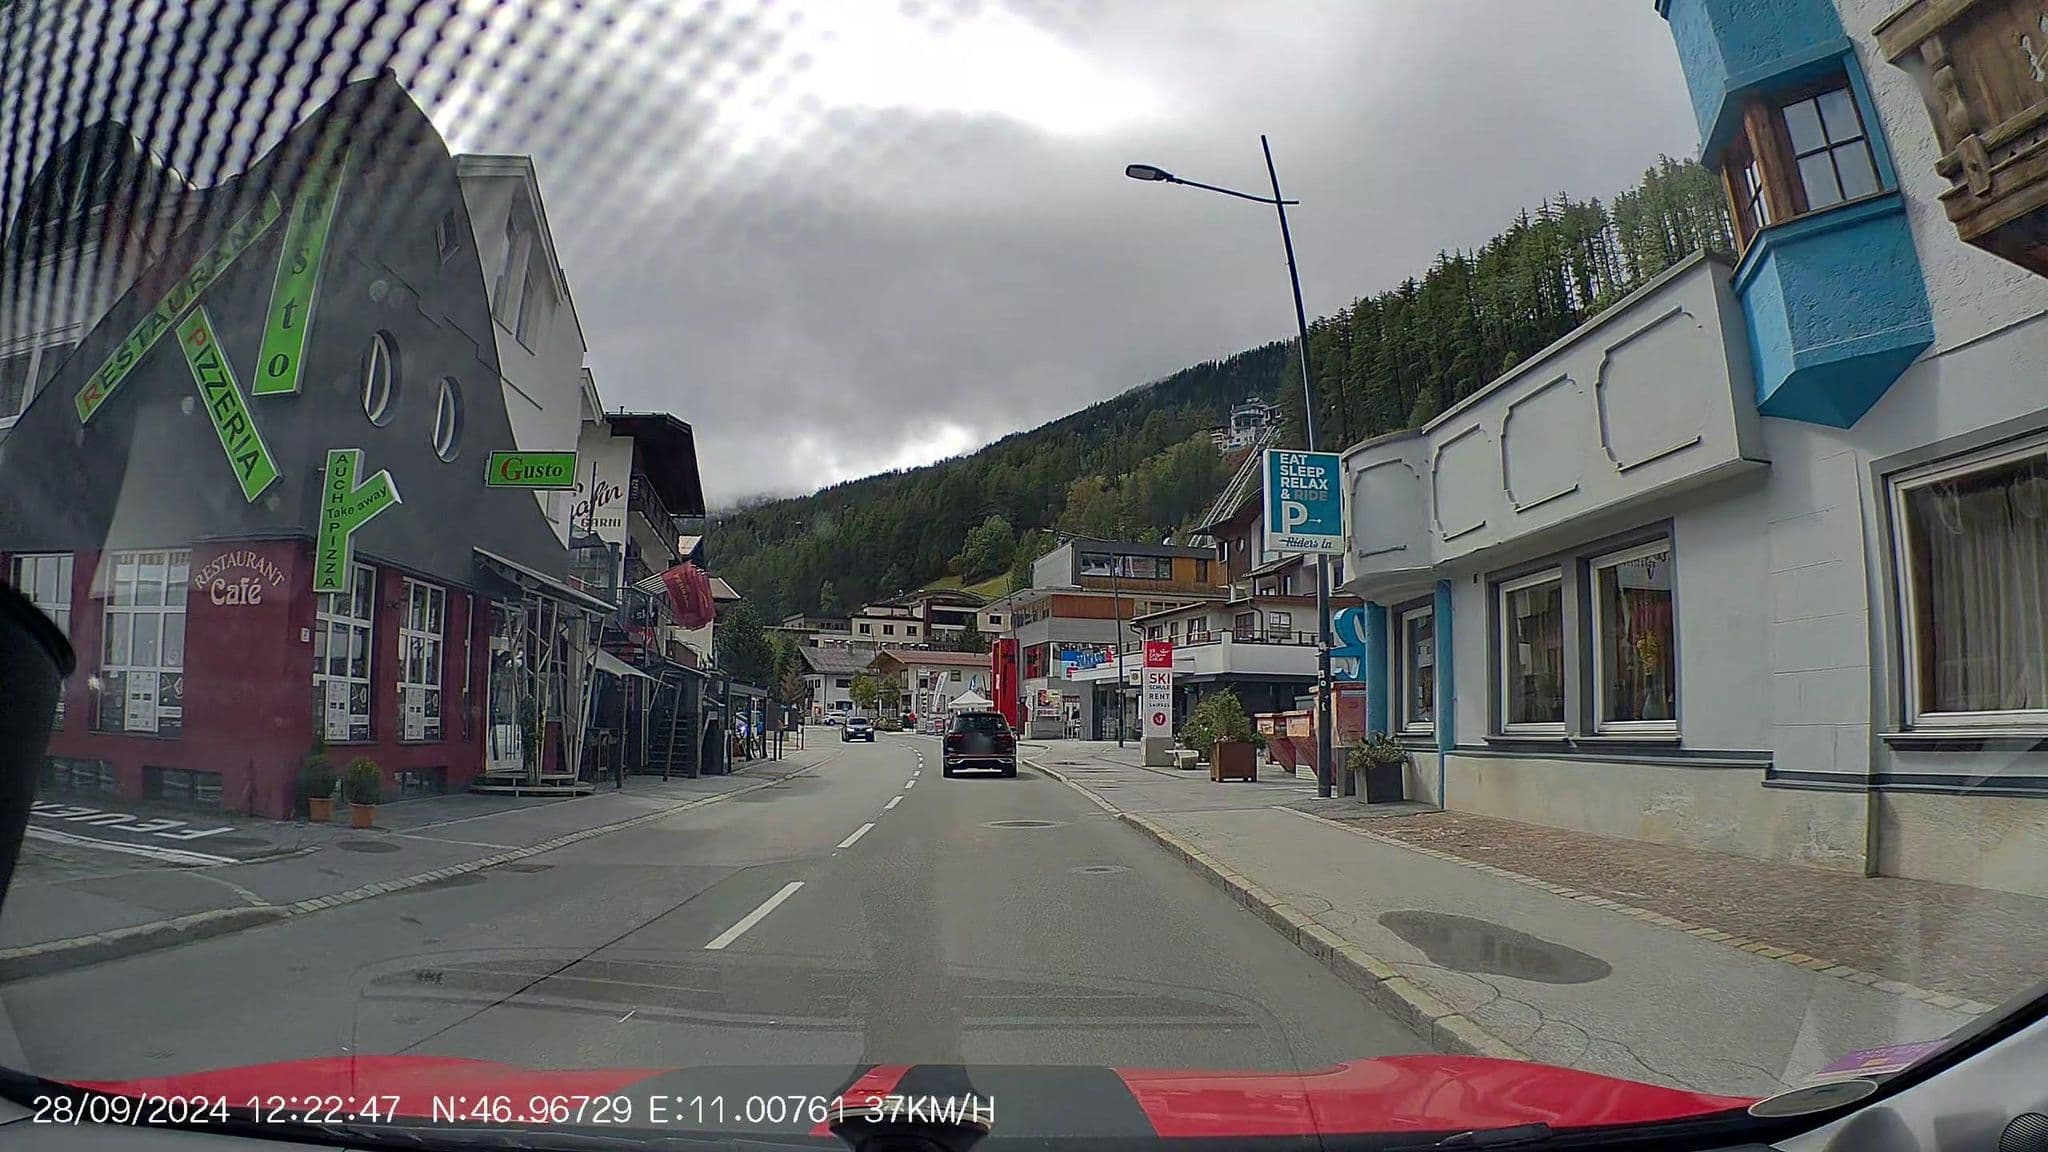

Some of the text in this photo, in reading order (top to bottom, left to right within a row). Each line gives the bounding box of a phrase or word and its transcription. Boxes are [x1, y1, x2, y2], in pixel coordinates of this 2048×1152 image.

[84, 208, 268, 410] RESTAURAN
[187, 327, 261, 480] PIZZERIA
[501, 457, 563, 480] Gusto
[1280, 453, 1308, 465] EAT
[1280, 465, 1325, 478] SLEEP
[331, 454, 349, 503] AUCH
[1281, 476, 1328, 490] RELAX
[326, 486, 388, 519] Take away
[1281, 488, 1328, 501] & RIDE
[1282, 500, 1308, 535] P
[323, 522, 340, 587] PIZZA
[1283, 536, 1319, 549] Riders
[194, 551, 285, 589] RESTAURANT
[210, 578, 262, 606] Café
[1149, 673, 1170, 685] SKI
